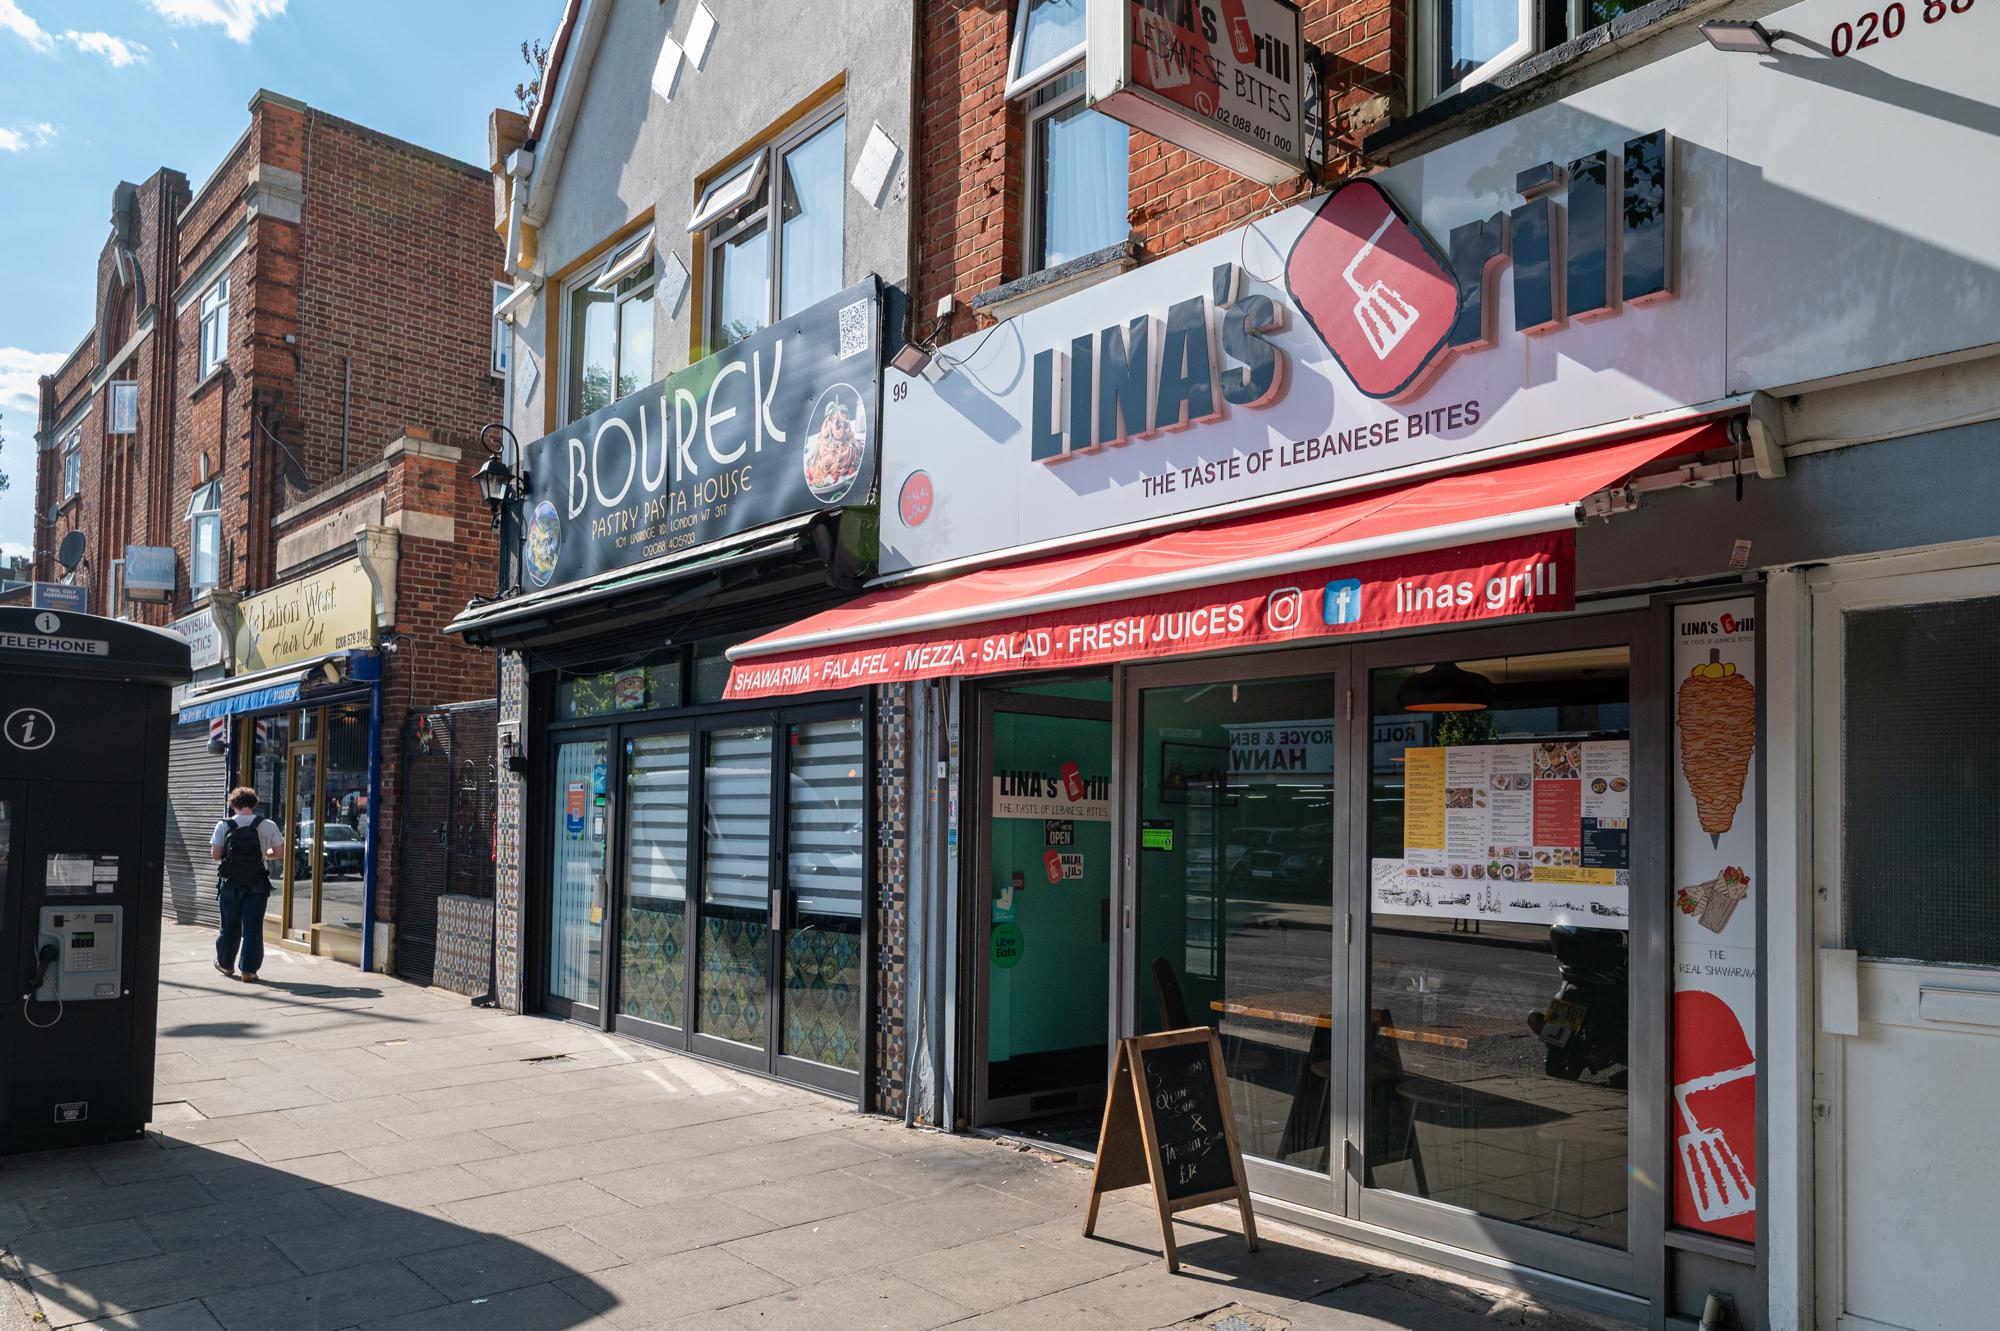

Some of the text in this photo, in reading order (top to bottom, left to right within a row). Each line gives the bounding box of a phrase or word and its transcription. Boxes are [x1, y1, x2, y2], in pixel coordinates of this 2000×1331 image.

[1831, 2, 1906, 58] 020
[1132, 15, 1291, 123] LEBANESE BITES
[1217, 106, 1292, 153] 02 088 401 000
[893, 381, 908, 402] 99
[568, 339, 786, 521] BOUREK
[1142, 399, 1481, 498] THE TASTE OF LEBANESE BITES
[591, 465, 753, 541] PASTRY PASTA HOUSE
[670, 513, 698, 532] LONDON
[701, 508, 711, 521] W7
[1396, 581, 1474, 613] linas
[1485, 562, 1557, 610] grill
[272, 616, 325, 663] Hair Cut
[734, 665, 810, 691] SHAWARMA
[822, 653, 889, 681] FALAFEL
[904, 643, 965, 671] MEZZA
[982, 632, 1051, 663] SALAD
[1069, 618, 1145, 653] FRESH
[1152, 604, 1244, 641] JUICES
[999, 803, 1109, 817] THE TASTE OF LEBANESE BITES
[1050, 831, 1071, 844] OPEN
[1061, 855, 1082, 865] HALAL
[1065, 866, 1082, 878] حلال
[996, 937, 1016, 947] Uber
[996, 948, 1016, 958] Eats
[1708, 949, 1726, 960] THE
[1679, 963, 1758, 978] REAL SHAWARMA
